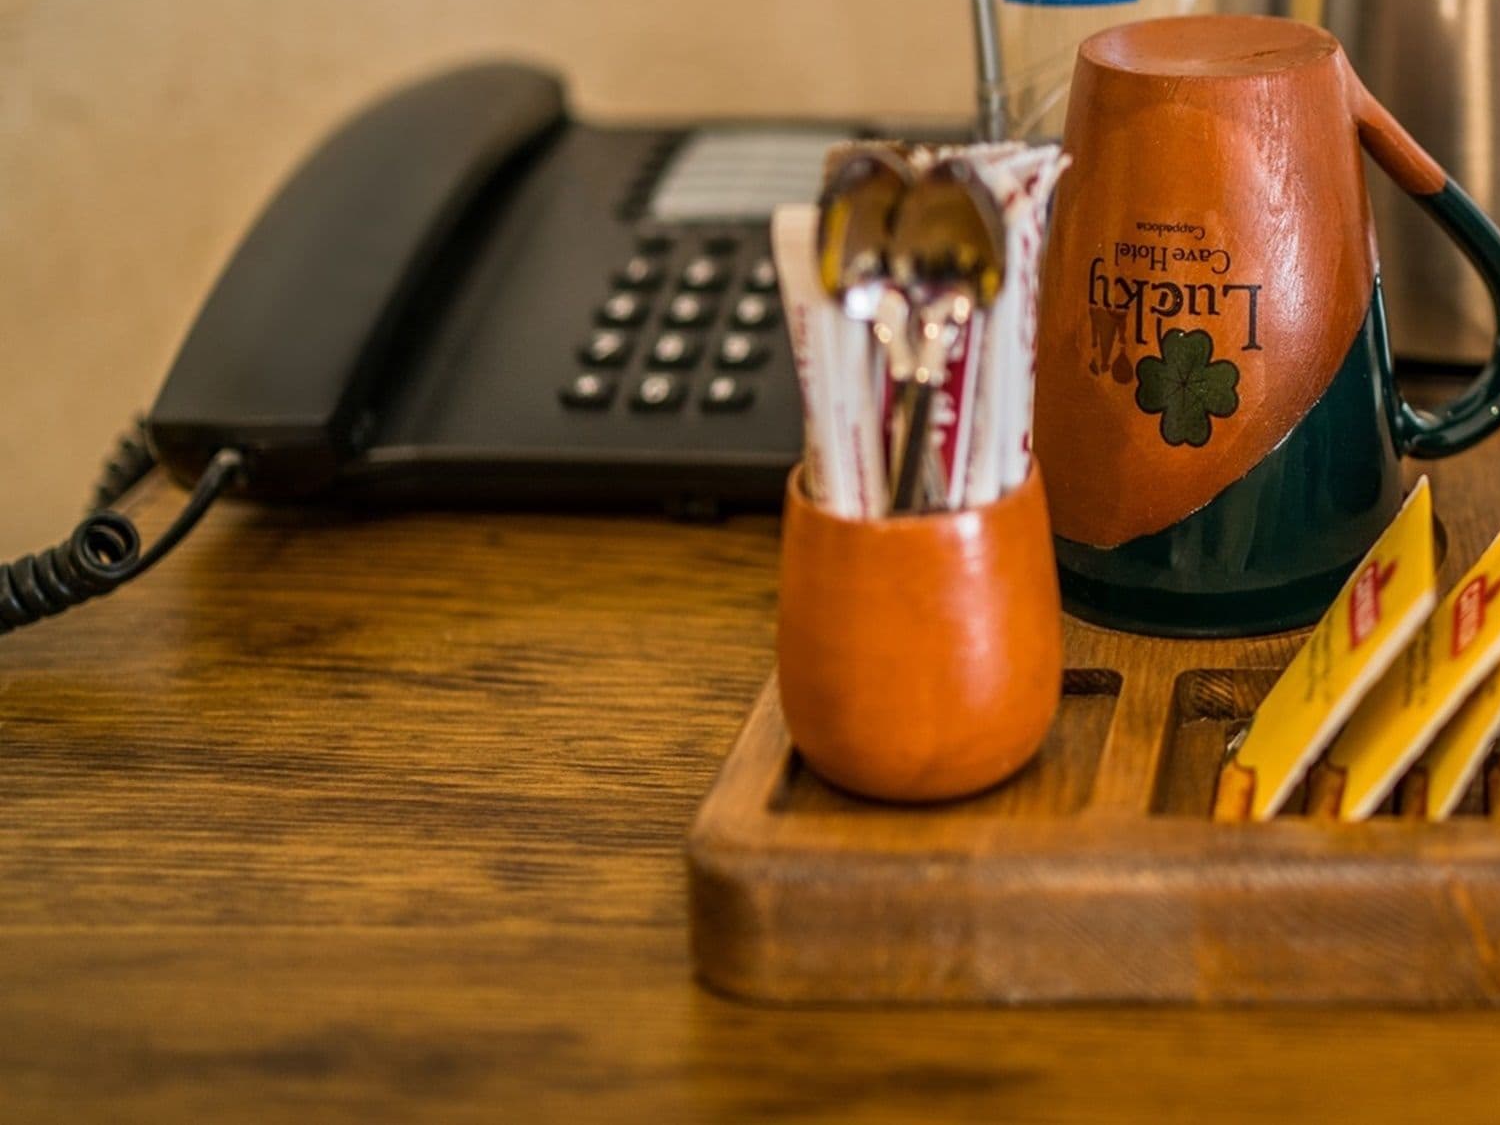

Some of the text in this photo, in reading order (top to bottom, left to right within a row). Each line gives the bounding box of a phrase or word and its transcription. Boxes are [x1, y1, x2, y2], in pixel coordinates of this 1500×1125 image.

[1136, 221, 1206, 240] Cappadocia
[1114, 242, 1231, 274] Cave Hotel
[1089, 257, 1262, 351] Lucky
